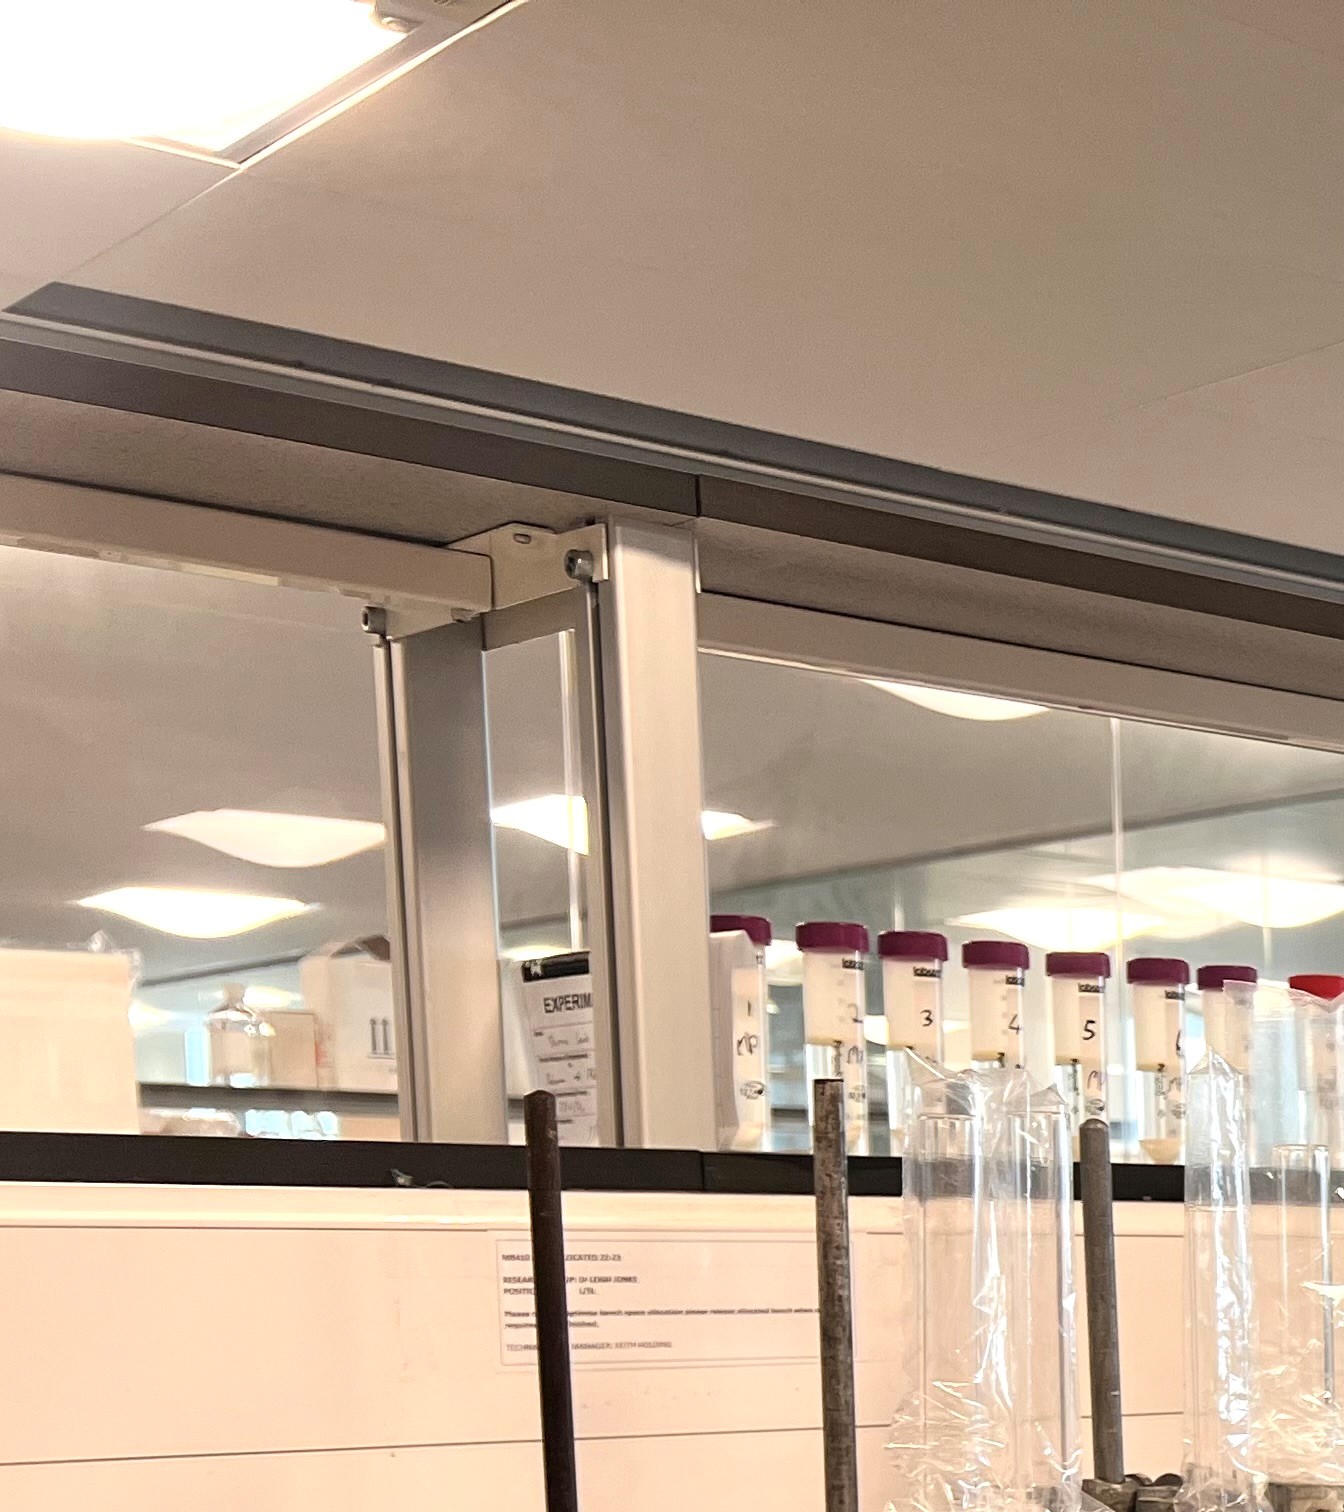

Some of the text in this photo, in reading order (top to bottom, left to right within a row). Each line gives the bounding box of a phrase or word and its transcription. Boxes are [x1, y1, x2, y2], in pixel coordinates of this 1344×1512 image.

[920, 1009, 934, 1027] 3
[1008, 1013, 1024, 1035] 4
[1082, 1019, 1096, 1041] 5
